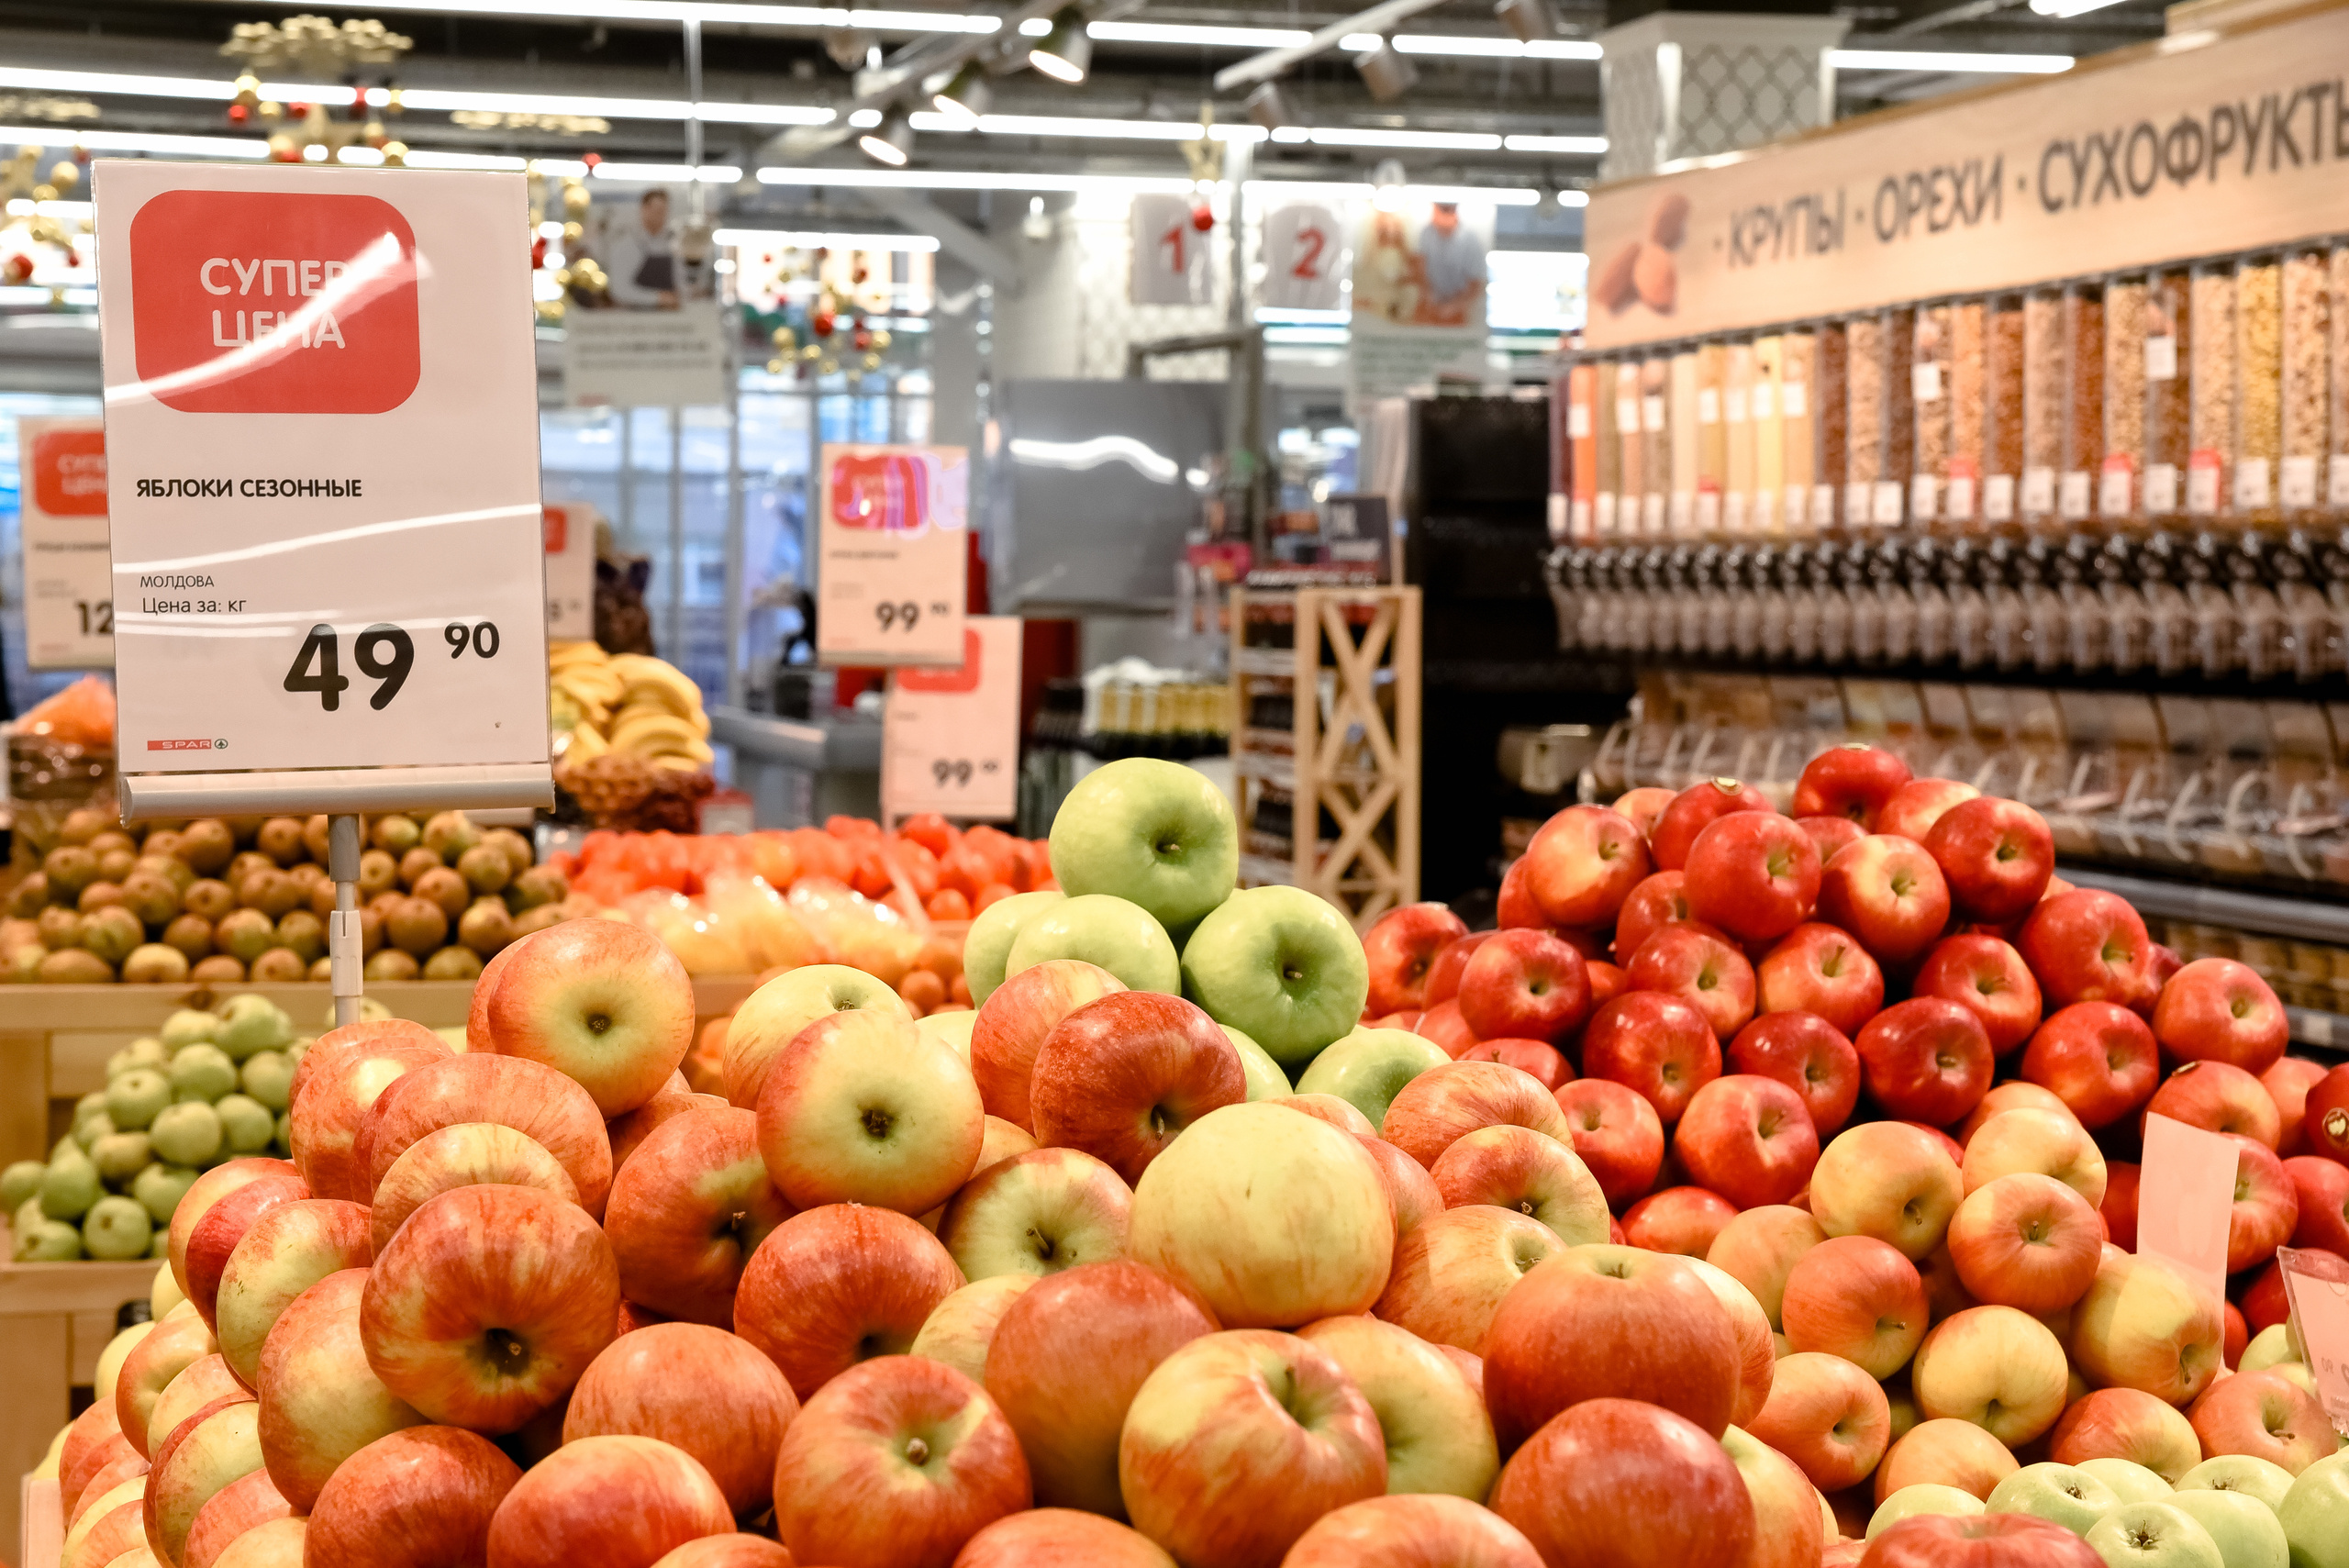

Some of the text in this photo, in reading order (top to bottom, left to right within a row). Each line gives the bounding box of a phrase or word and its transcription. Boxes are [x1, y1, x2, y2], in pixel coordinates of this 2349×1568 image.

[1728, 185, 1847, 268] КРУПЫ
[1874, 152, 2005, 246] ОРЕХИ
[1160, 225, 1185, 273] 1
[1292, 227, 1327, 280] 2
[136, 478, 363, 498] ЯБЛОКИ СЕЗОННЫЕ
[139, 574, 216, 590] МОЛДОВА
[141, 596, 248, 616] Цена за: кг
[874, 601, 921, 633] 99
[283, 620, 501, 712] 49 90
[161, 739, 212, 751] SPAR
[931, 757, 974, 789] 99
